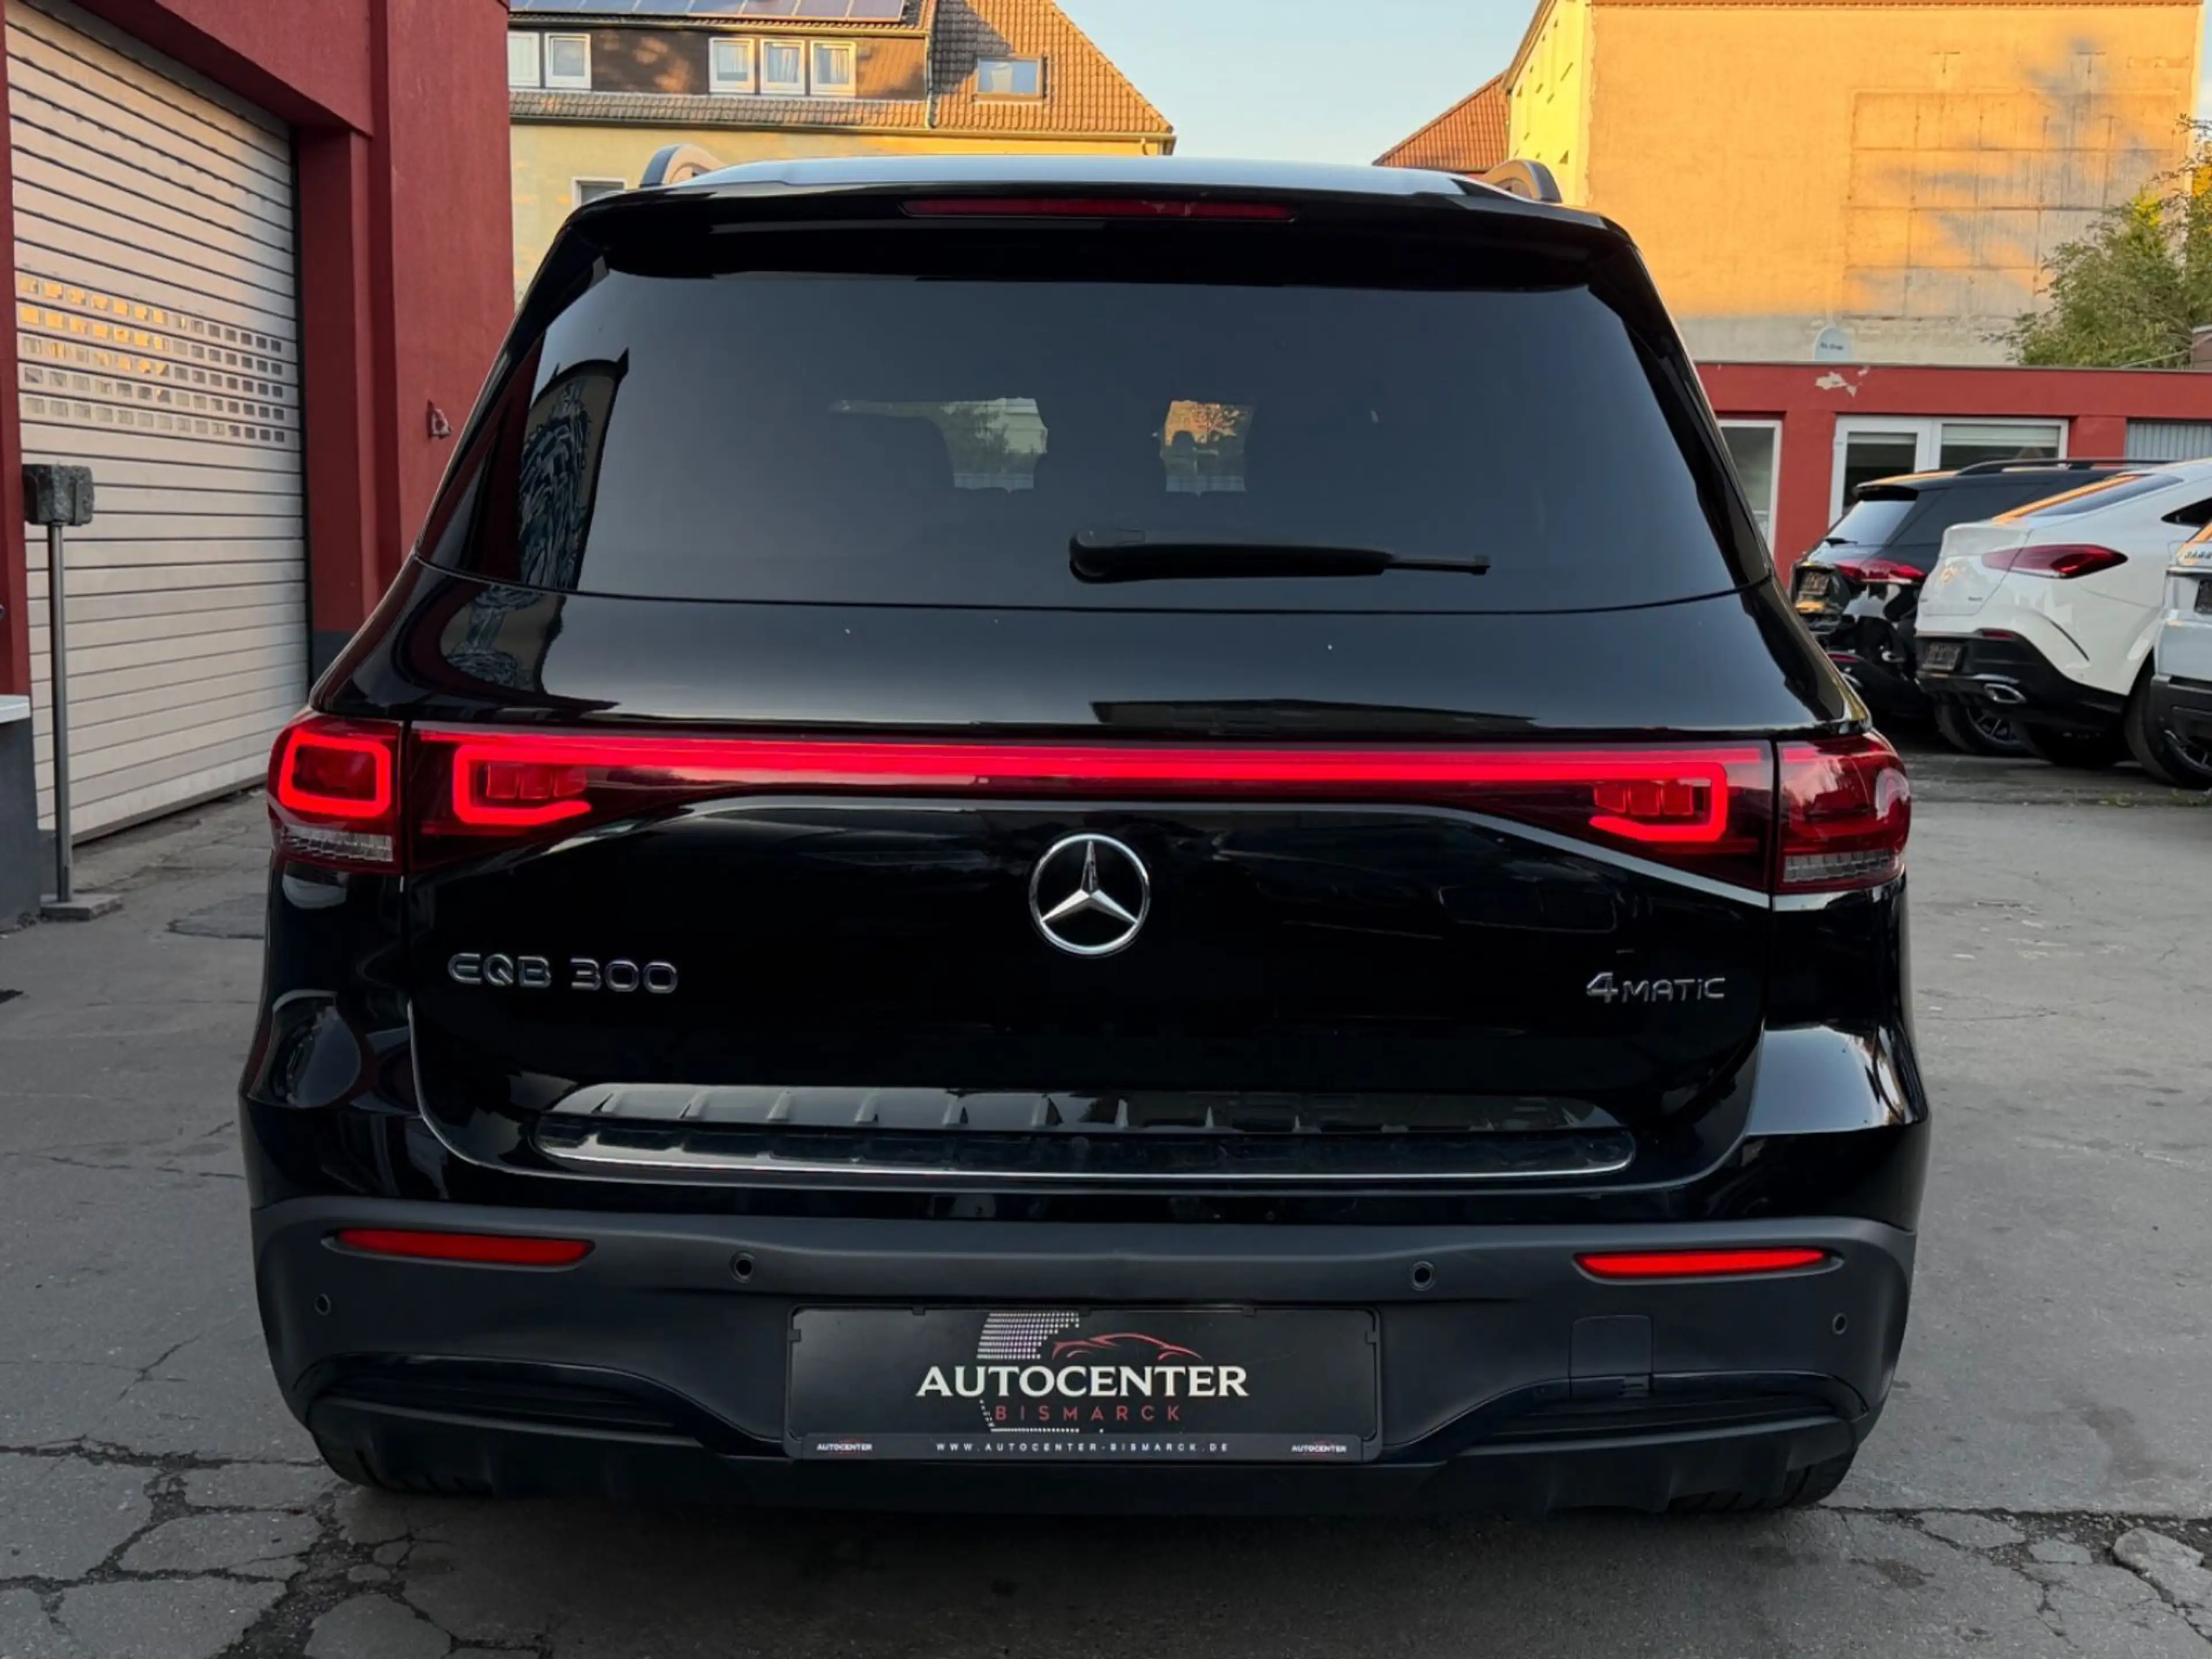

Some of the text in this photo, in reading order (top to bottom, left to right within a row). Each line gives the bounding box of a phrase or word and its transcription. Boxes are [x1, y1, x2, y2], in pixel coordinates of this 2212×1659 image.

[447, 952, 679, 994] EQB 300
[915, 1365, 1250, 1397] AUTOCENTER
[994, 1405, 1181, 1421] BISMARCK
[816, 1443, 873, 1452] AUTOCENTER
[1291, 1444, 1347, 1453] AUTOCENTER
